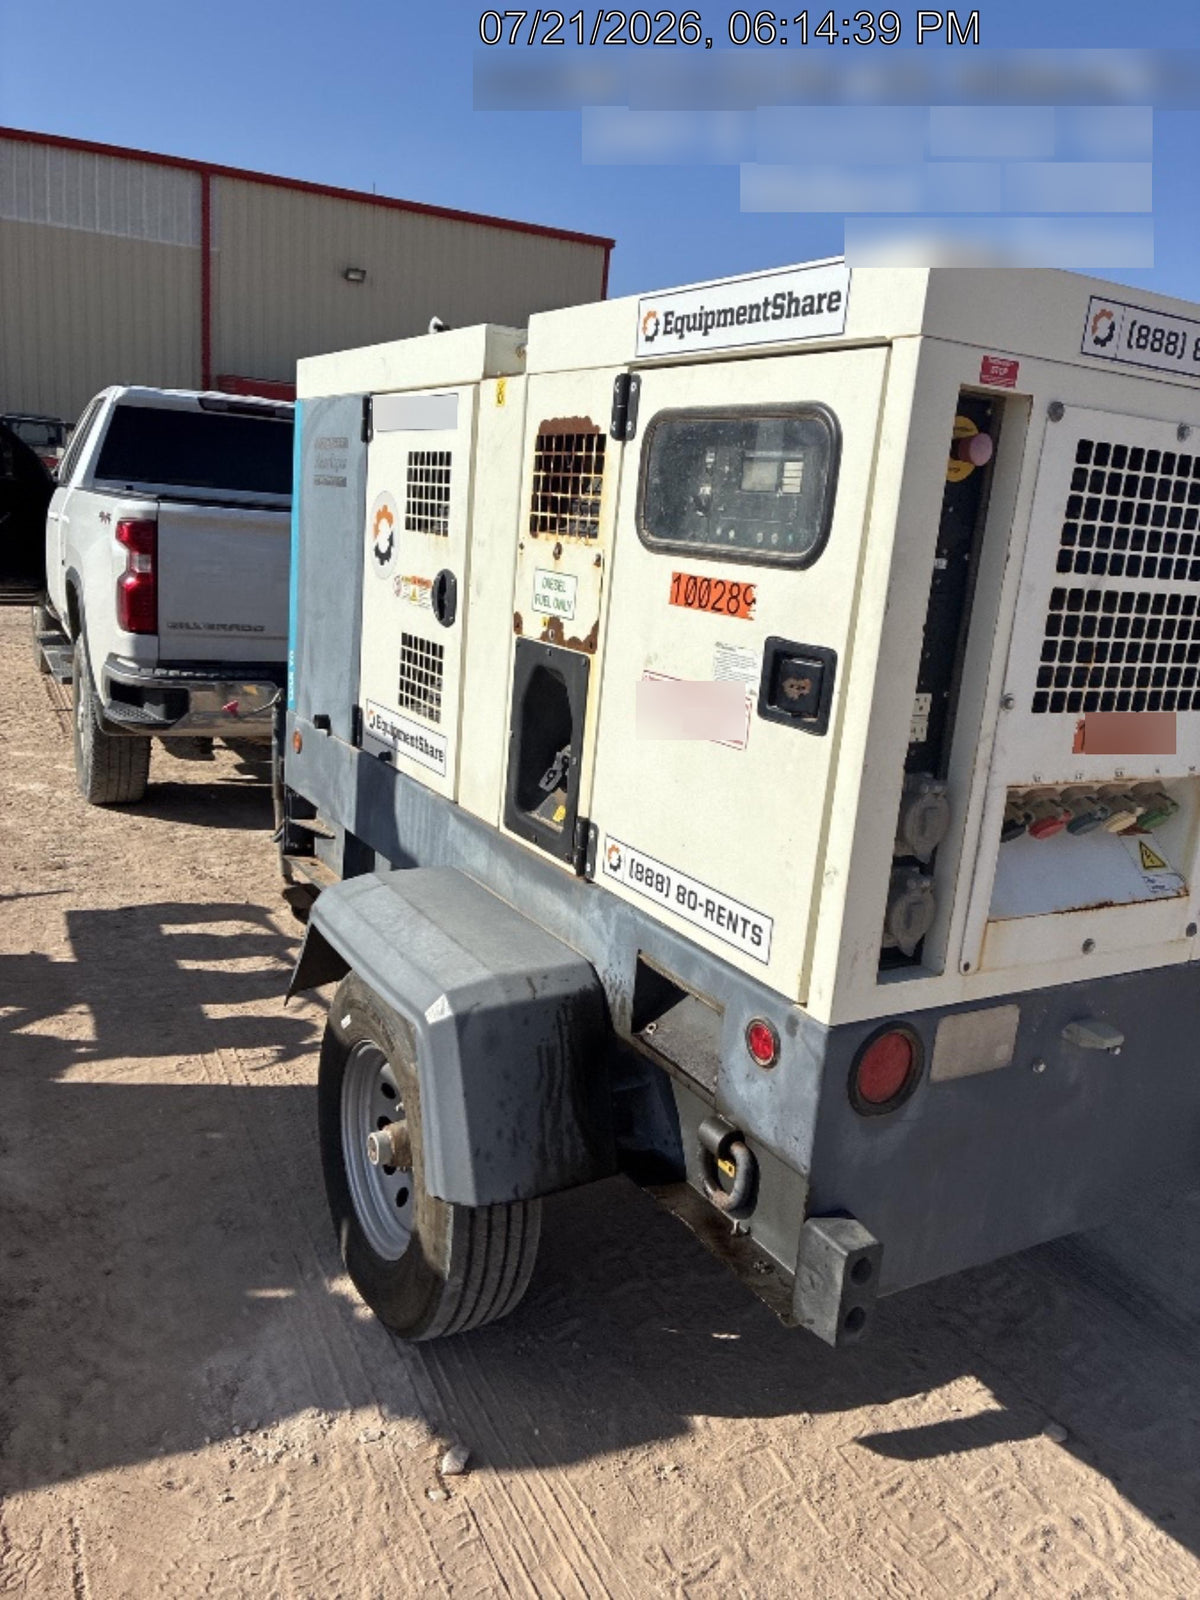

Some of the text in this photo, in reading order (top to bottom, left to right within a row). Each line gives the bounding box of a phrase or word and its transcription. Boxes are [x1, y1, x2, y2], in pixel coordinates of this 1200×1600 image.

[663, 290, 842, 339] EquipmentShare
[1127, 320, 1187, 360] (888)
[535, 593, 573, 612] FUEL ONLY
[542, 577, 566, 592] DIESEL
[376, 713, 444, 763] EquipmentShare
[629, 858, 764, 946] (888) 80-RENTS
